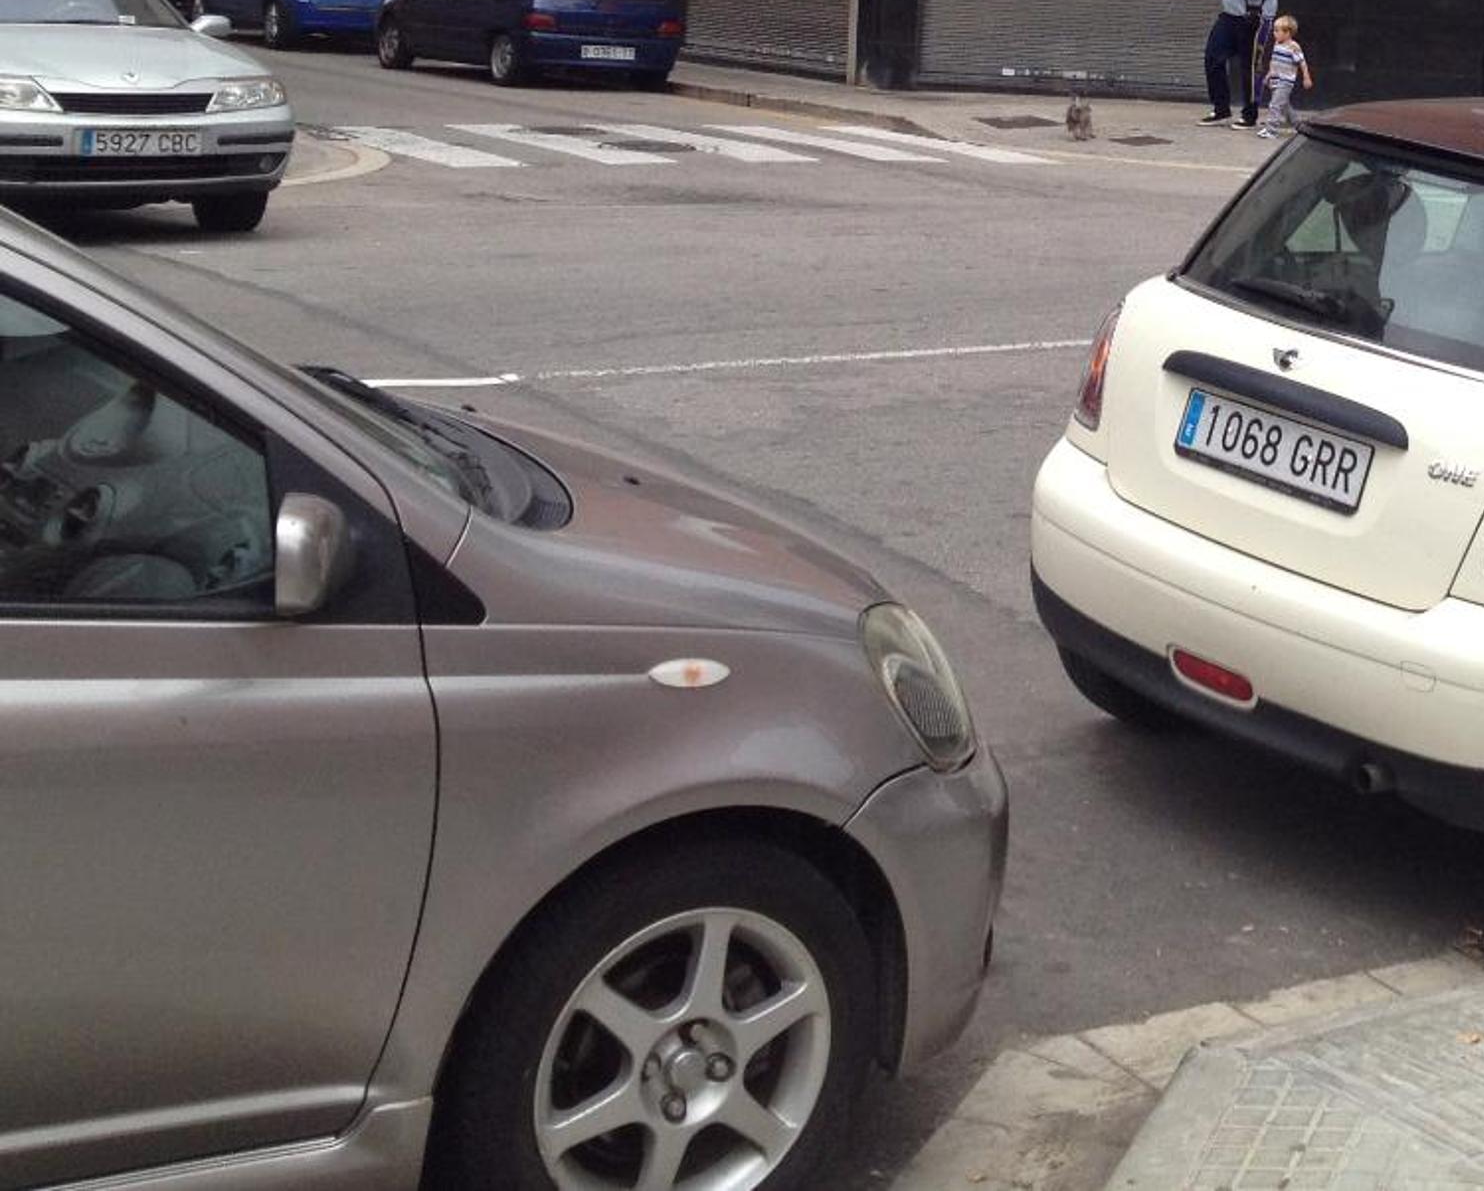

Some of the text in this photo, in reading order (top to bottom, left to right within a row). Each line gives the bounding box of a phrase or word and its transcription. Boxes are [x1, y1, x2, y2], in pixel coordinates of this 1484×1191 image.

[96, 133, 197, 153] 5927 CBC
[1206, 405, 1358, 494] 1068 GRR
